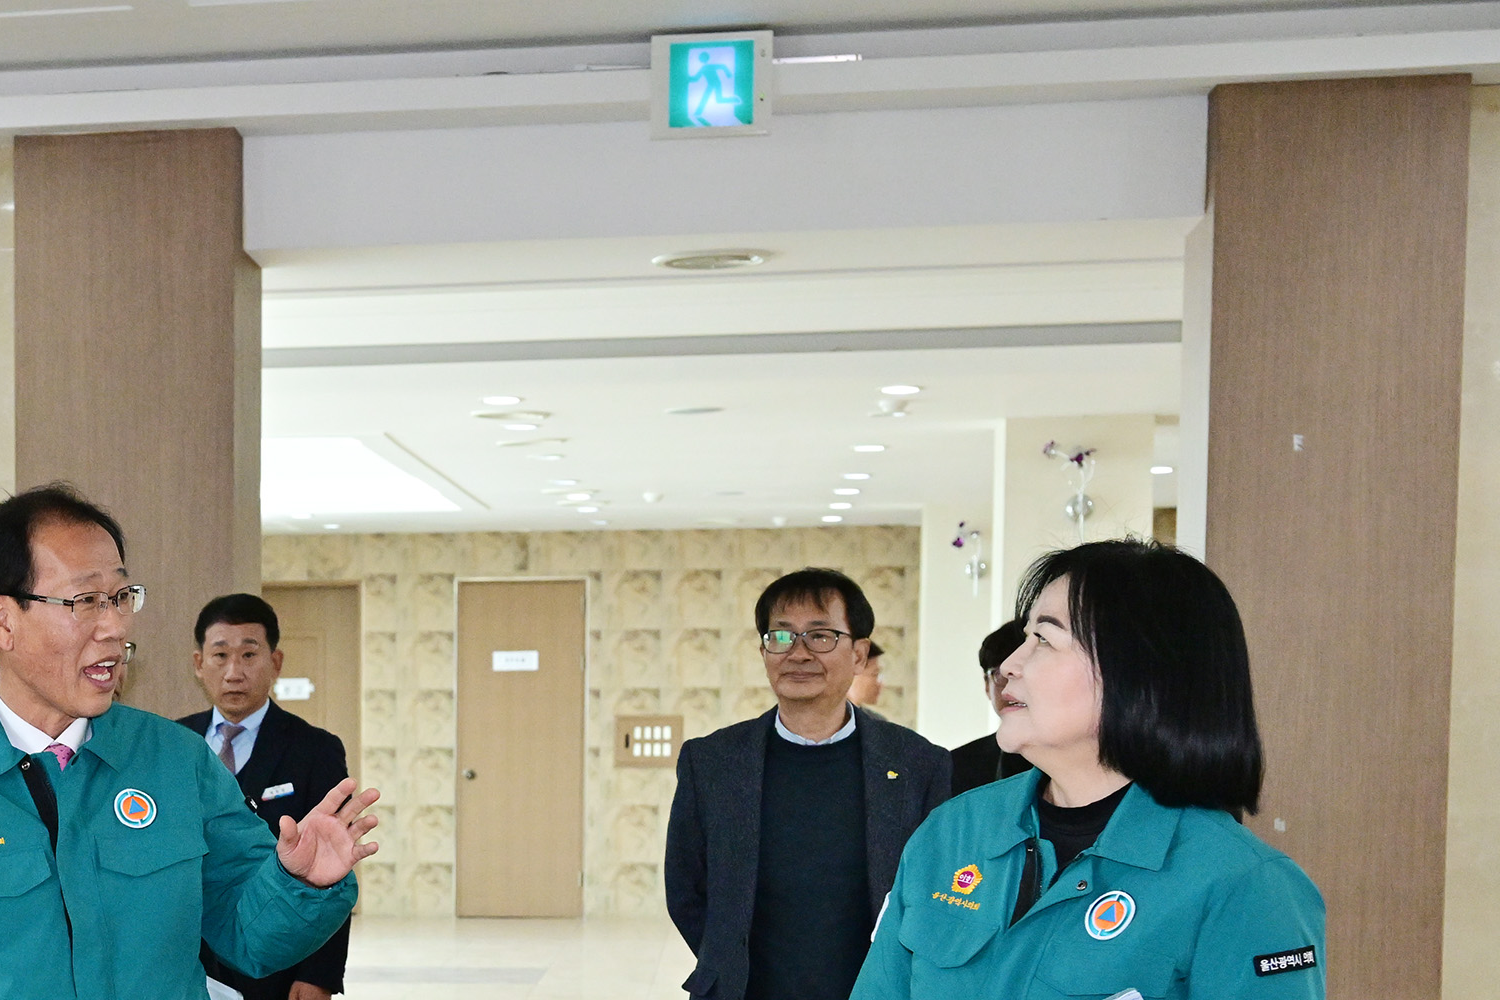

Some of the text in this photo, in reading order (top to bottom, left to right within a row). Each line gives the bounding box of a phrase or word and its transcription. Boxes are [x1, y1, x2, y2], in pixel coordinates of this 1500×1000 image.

[958, 873, 975, 884] 의회
[932, 892, 980, 910] 울산광역시의회
[1260, 953, 1303, 972] 울산광역시
